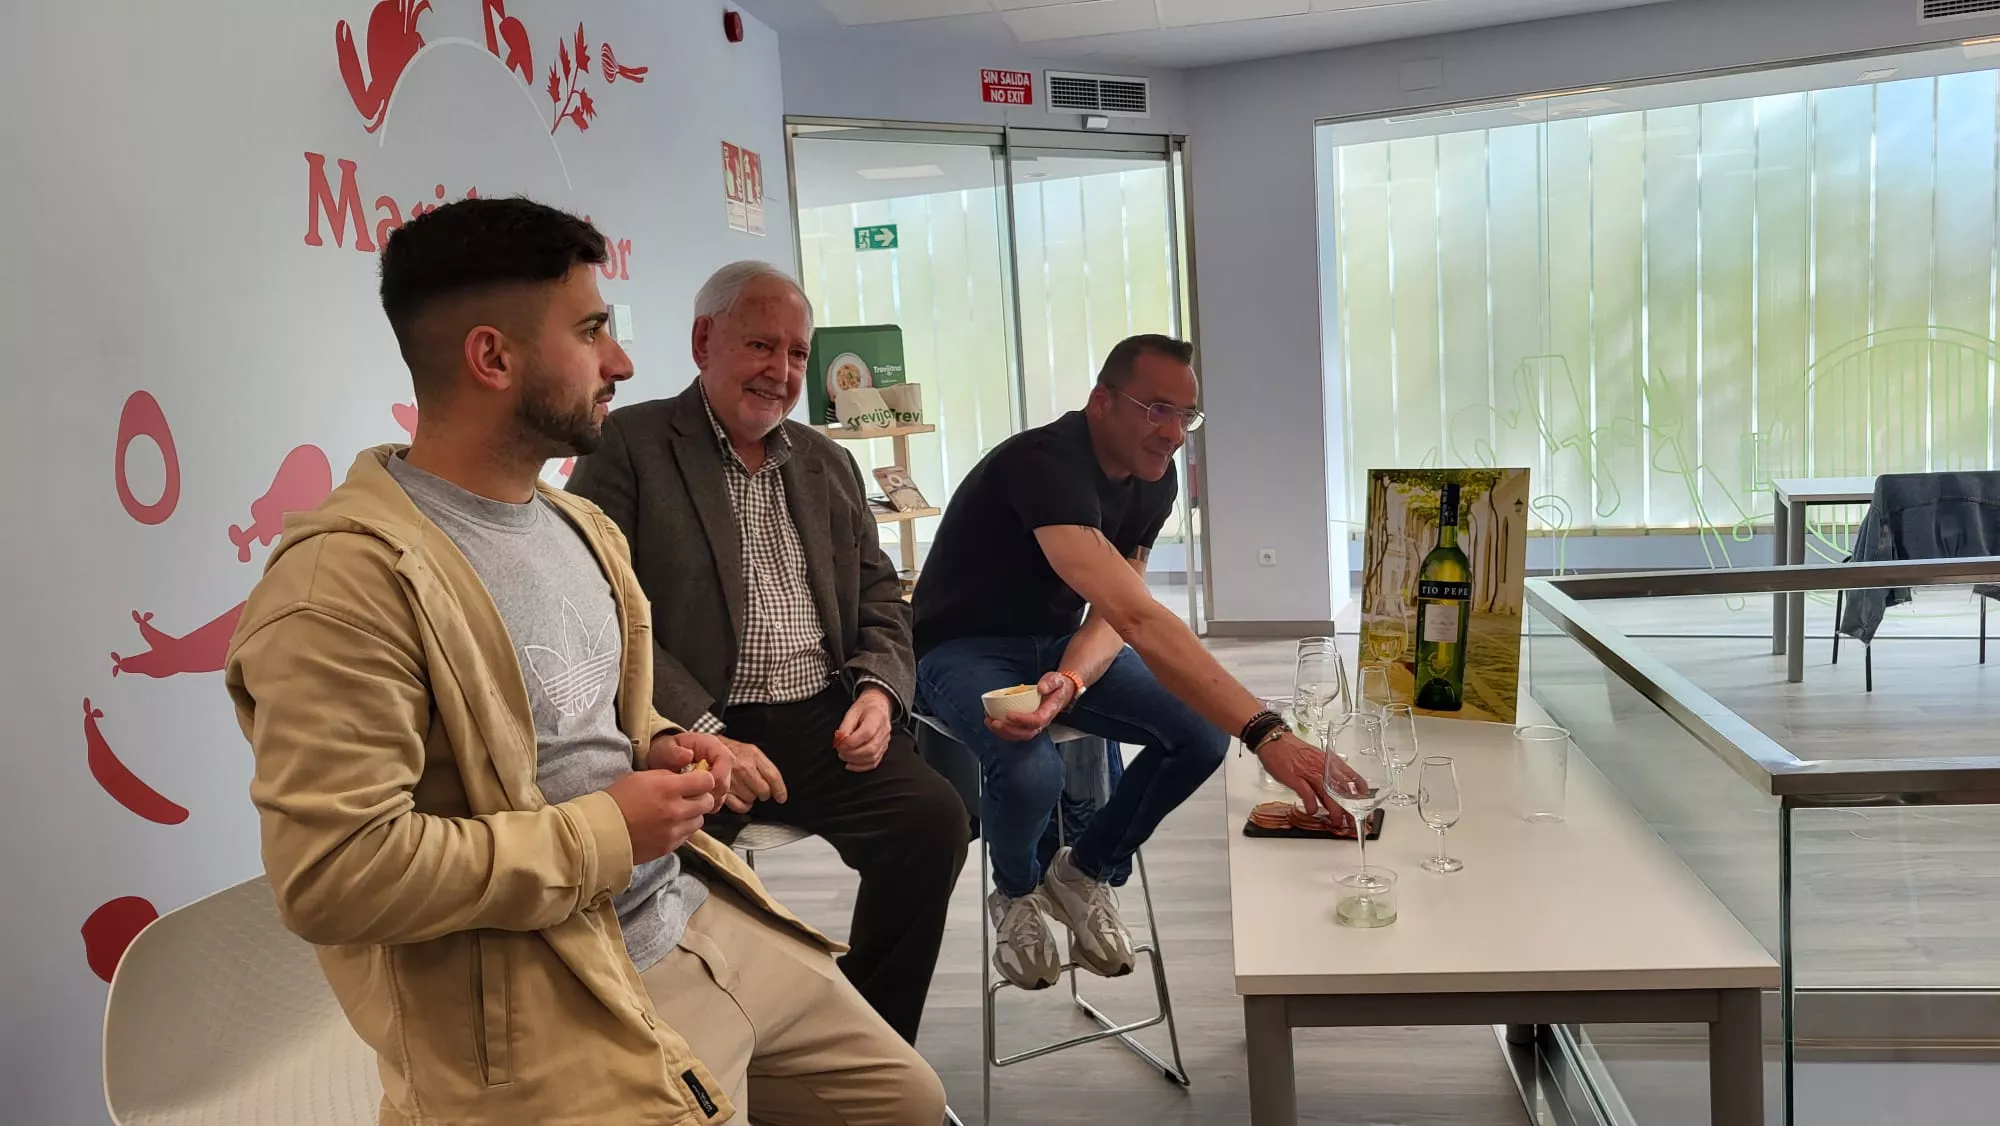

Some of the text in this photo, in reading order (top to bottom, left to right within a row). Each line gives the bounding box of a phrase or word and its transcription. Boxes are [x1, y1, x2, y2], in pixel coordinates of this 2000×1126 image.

[983, 71, 1030, 85] SIN SALIDA
[990, 89, 1024, 103] NO EXIT
[1422, 586, 1468, 596] TIO PEPE
